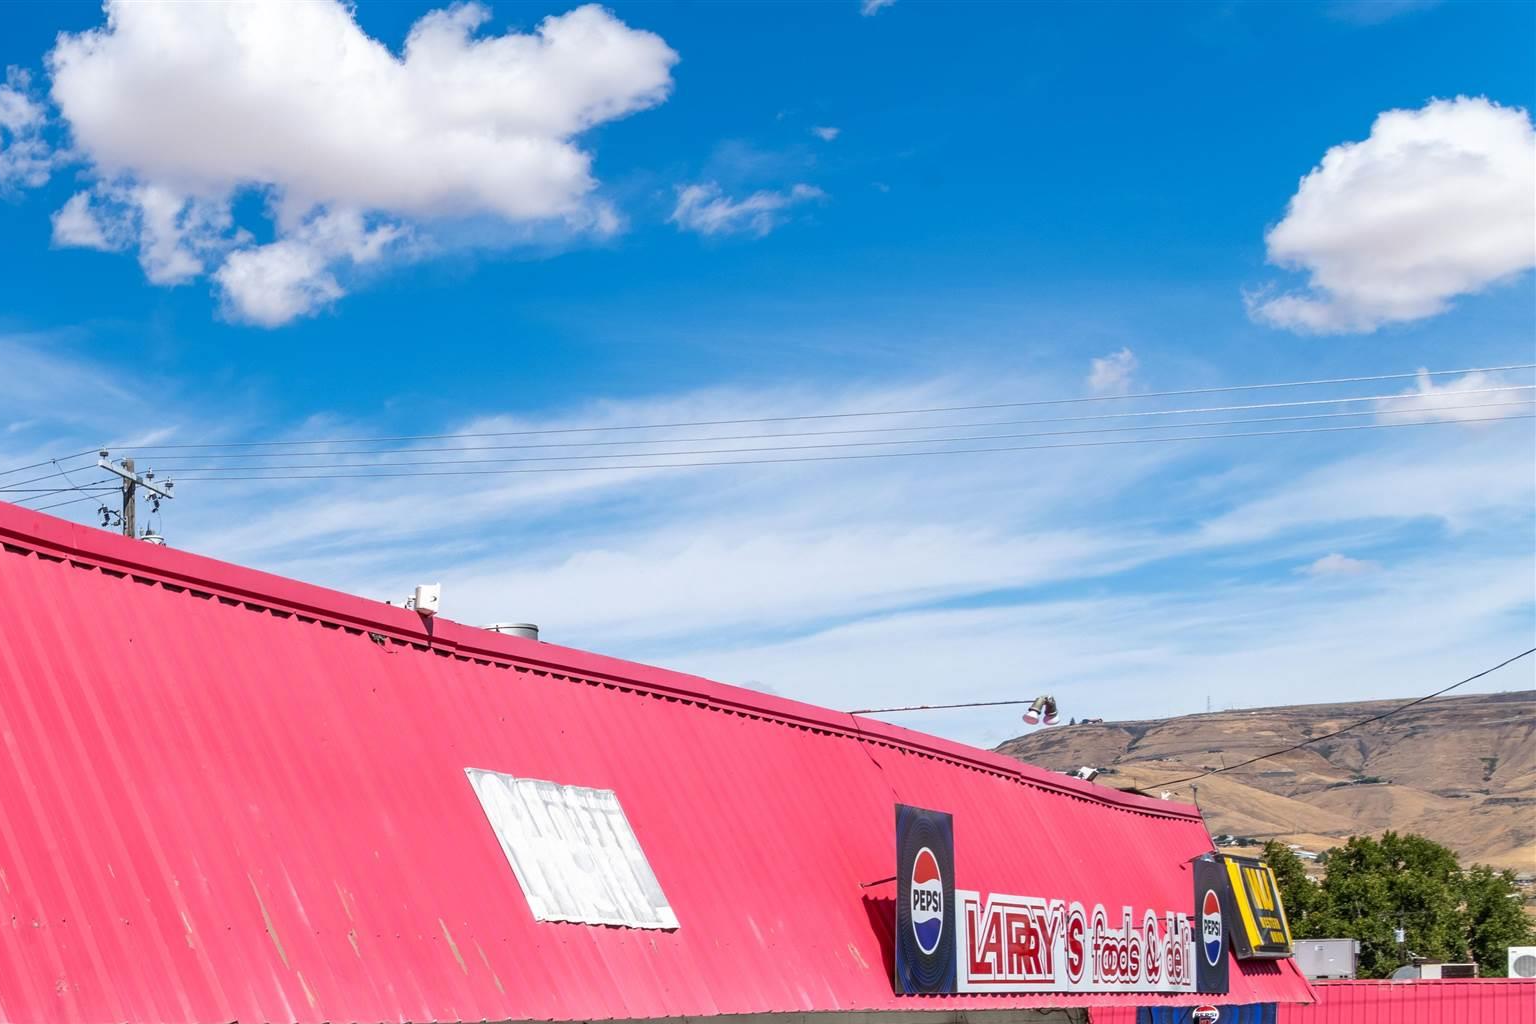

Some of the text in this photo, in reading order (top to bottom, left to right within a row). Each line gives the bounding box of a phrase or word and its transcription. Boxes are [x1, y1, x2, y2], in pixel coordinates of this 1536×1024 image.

[914, 889, 941, 912] PEPSI
[1204, 919, 1221, 937] PEPSI
[965, 900, 1085, 983] LARRY'S
[1092, 910, 1141, 984] foods
[1145, 916, 1162, 984] &
